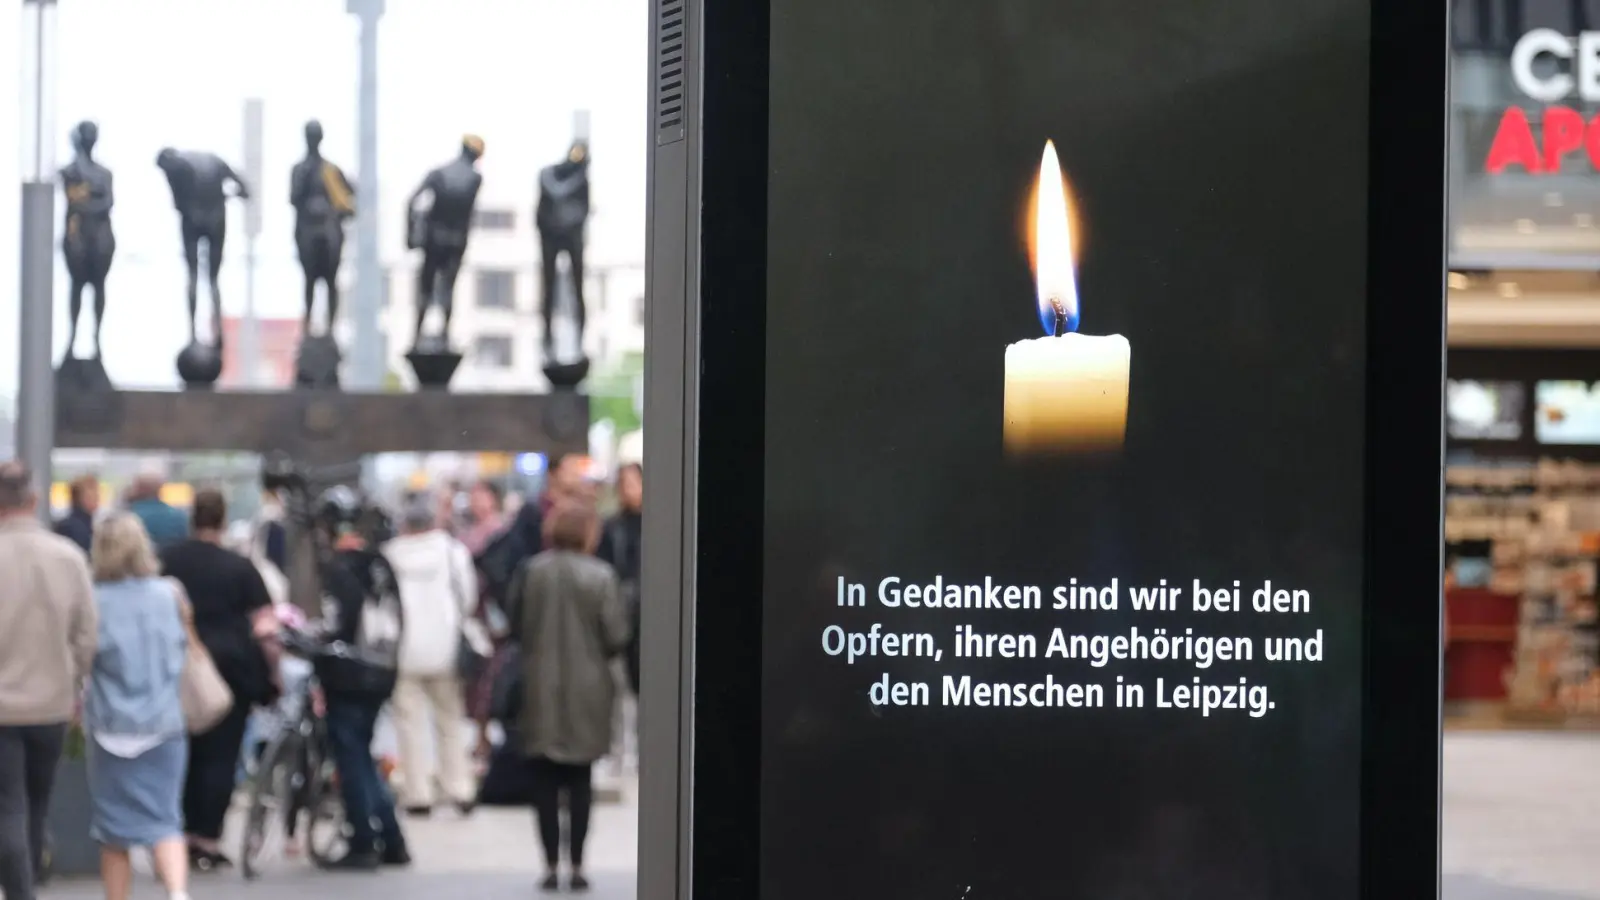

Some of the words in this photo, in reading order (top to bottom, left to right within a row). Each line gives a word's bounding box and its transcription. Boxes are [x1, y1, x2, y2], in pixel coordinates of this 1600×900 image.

[1485, 106, 1600, 174] AP
[837, 576, 866, 607] In
[878, 575, 1041, 609] Gedanken
[1053, 578, 1118, 610] sind
[1129, 579, 1181, 610] wir
[1193, 579, 1241, 612] bei
[1252, 580, 1310, 612] den
[821, 624, 943, 664] Opfern,
[955, 625, 1036, 658] ihren
[1045, 627, 1252, 668] Angehörigen
[1264, 629, 1323, 662] und
[869, 673, 929, 705] den
[942, 674, 1104, 707] Menschen
[1116, 676, 1143, 707] in
[1157, 677, 1276, 717] Leipzig.
